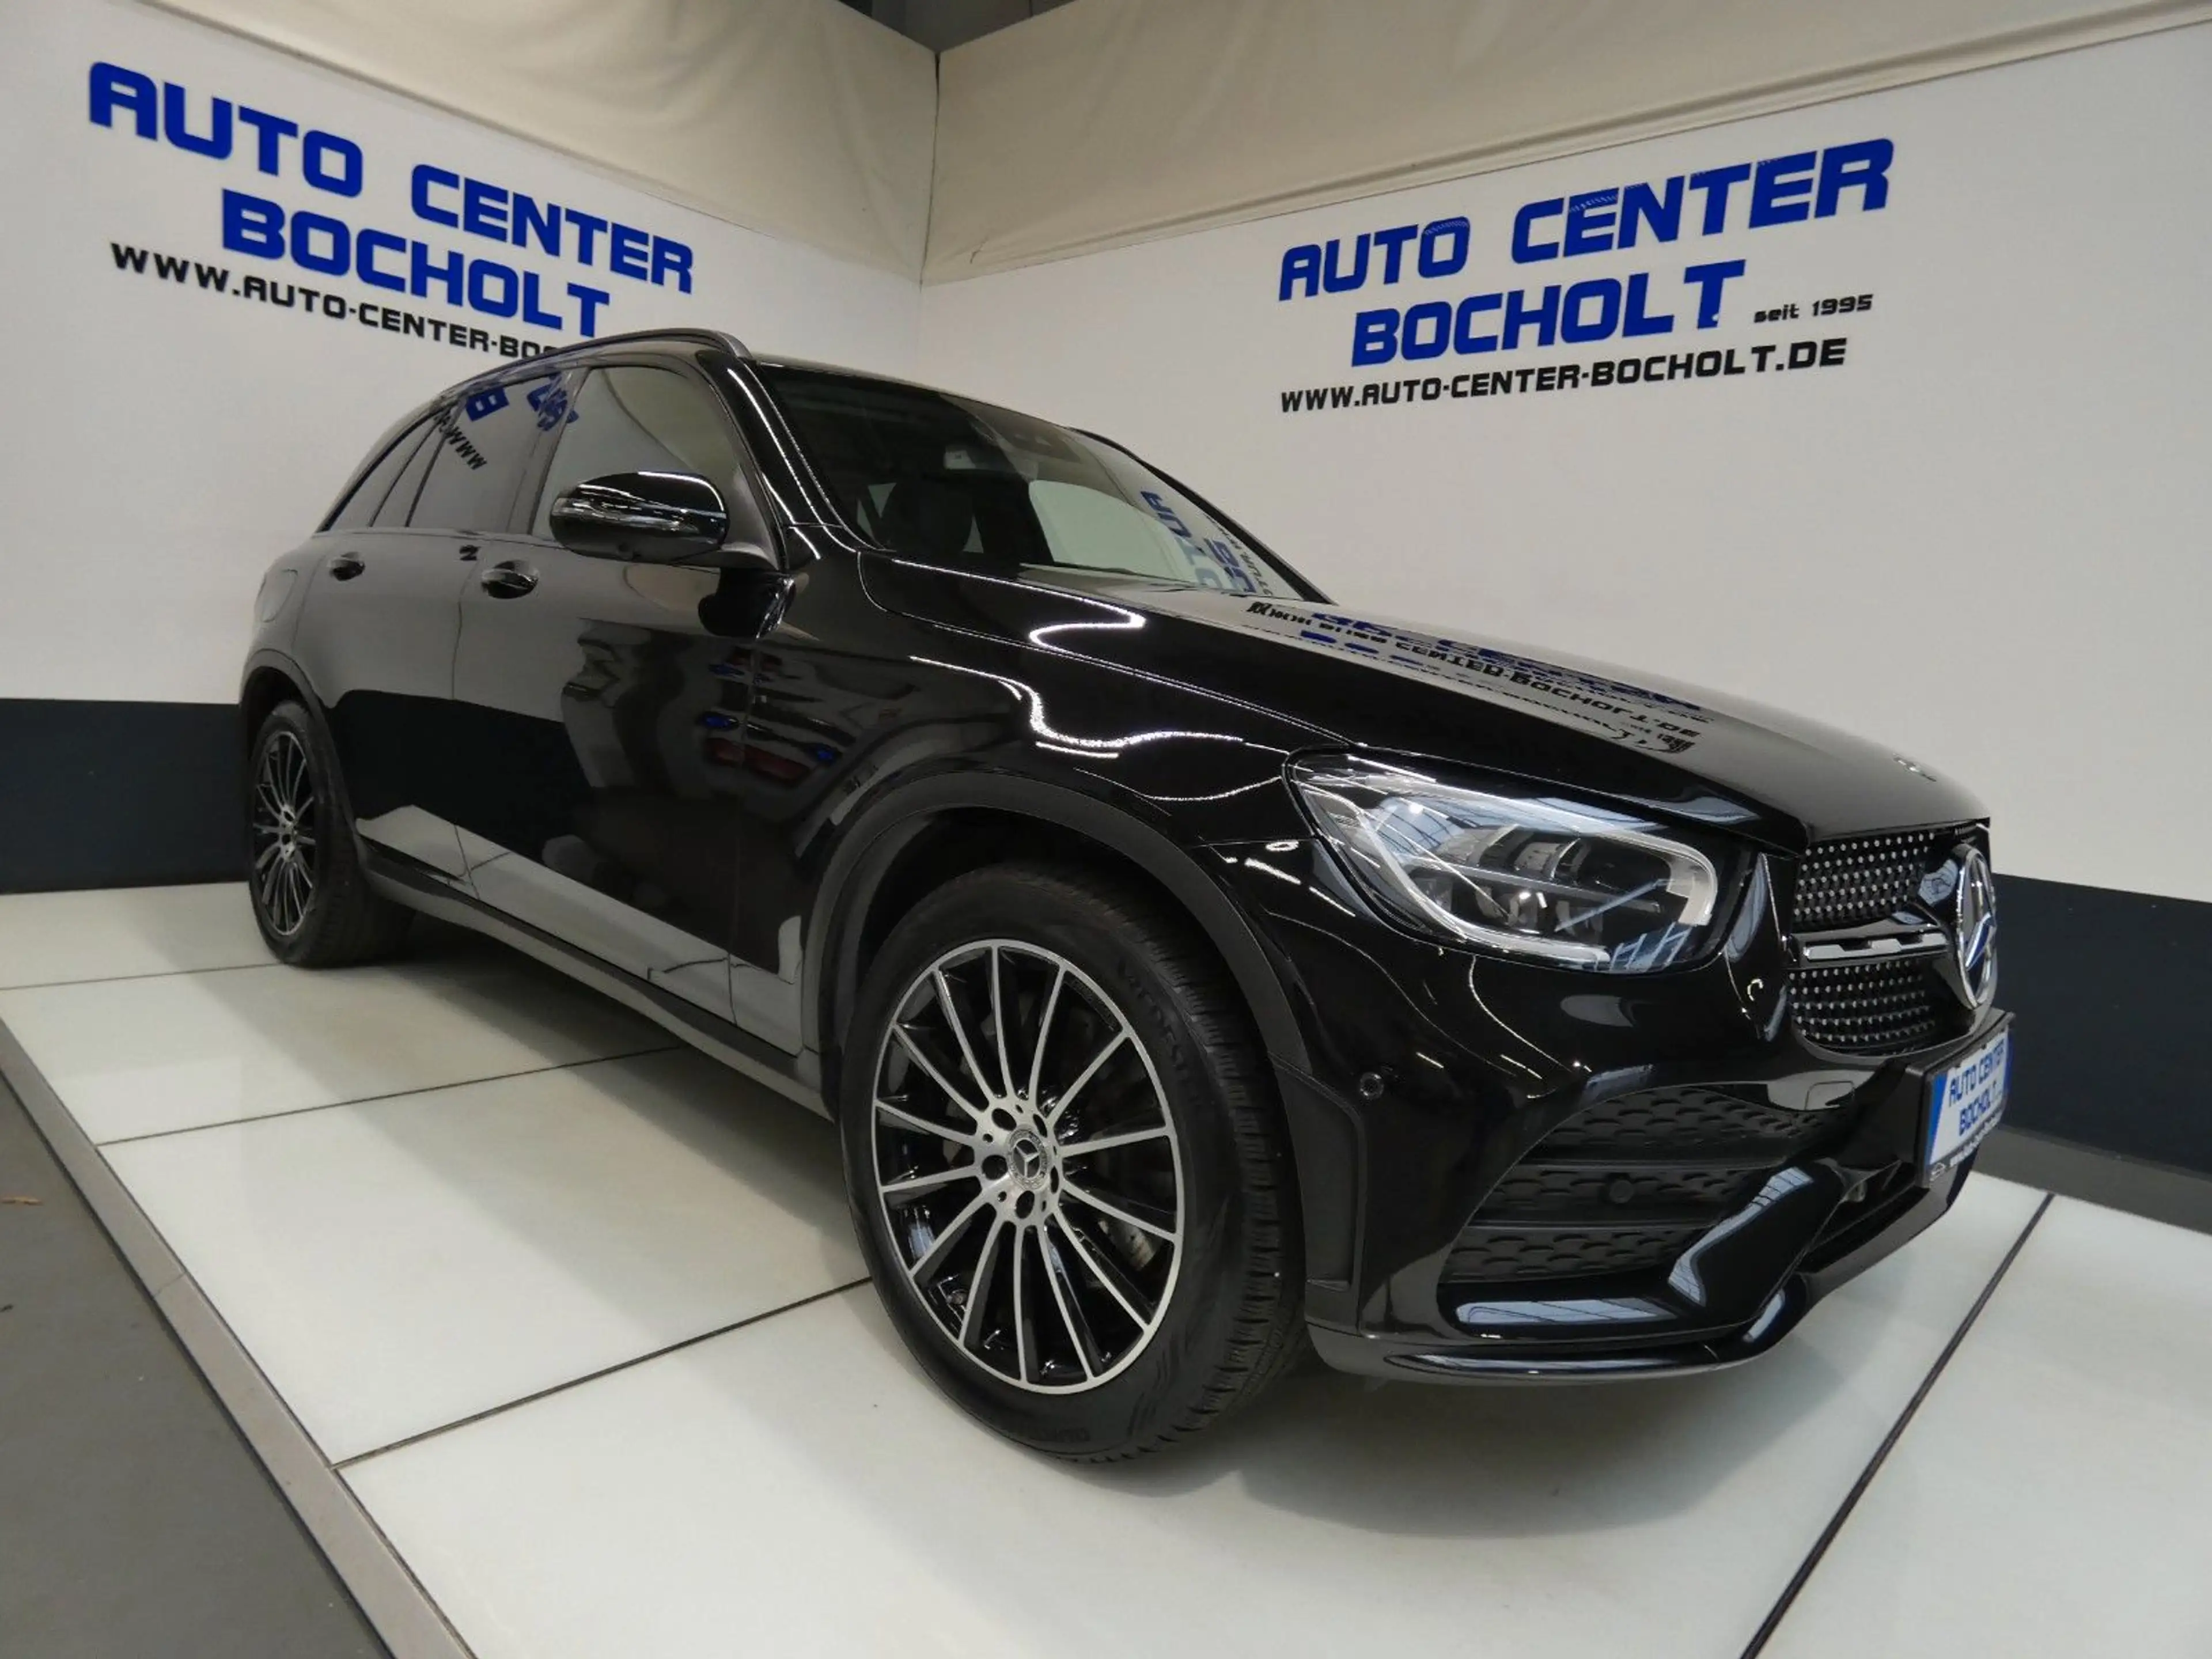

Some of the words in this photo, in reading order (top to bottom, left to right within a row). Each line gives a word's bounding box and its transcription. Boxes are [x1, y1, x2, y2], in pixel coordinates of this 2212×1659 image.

[89, 62, 364, 198] AUTO
[410, 164, 694, 294] CENTER
[1279, 217, 1470, 301] AUTO
[1511, 138, 1894, 264] CENTER
[222, 188, 611, 338] BOCHOLT
[1351, 259, 1747, 367] BOCHOLT
[1753, 304, 1800, 323] seit
[1812, 294, 1873, 317] 1995
[1281, 338, 1847, 412] WWW.AUTO-CENTER-BOCHOLT.DE
[1949, 1064, 1976, 1107] AUTO
